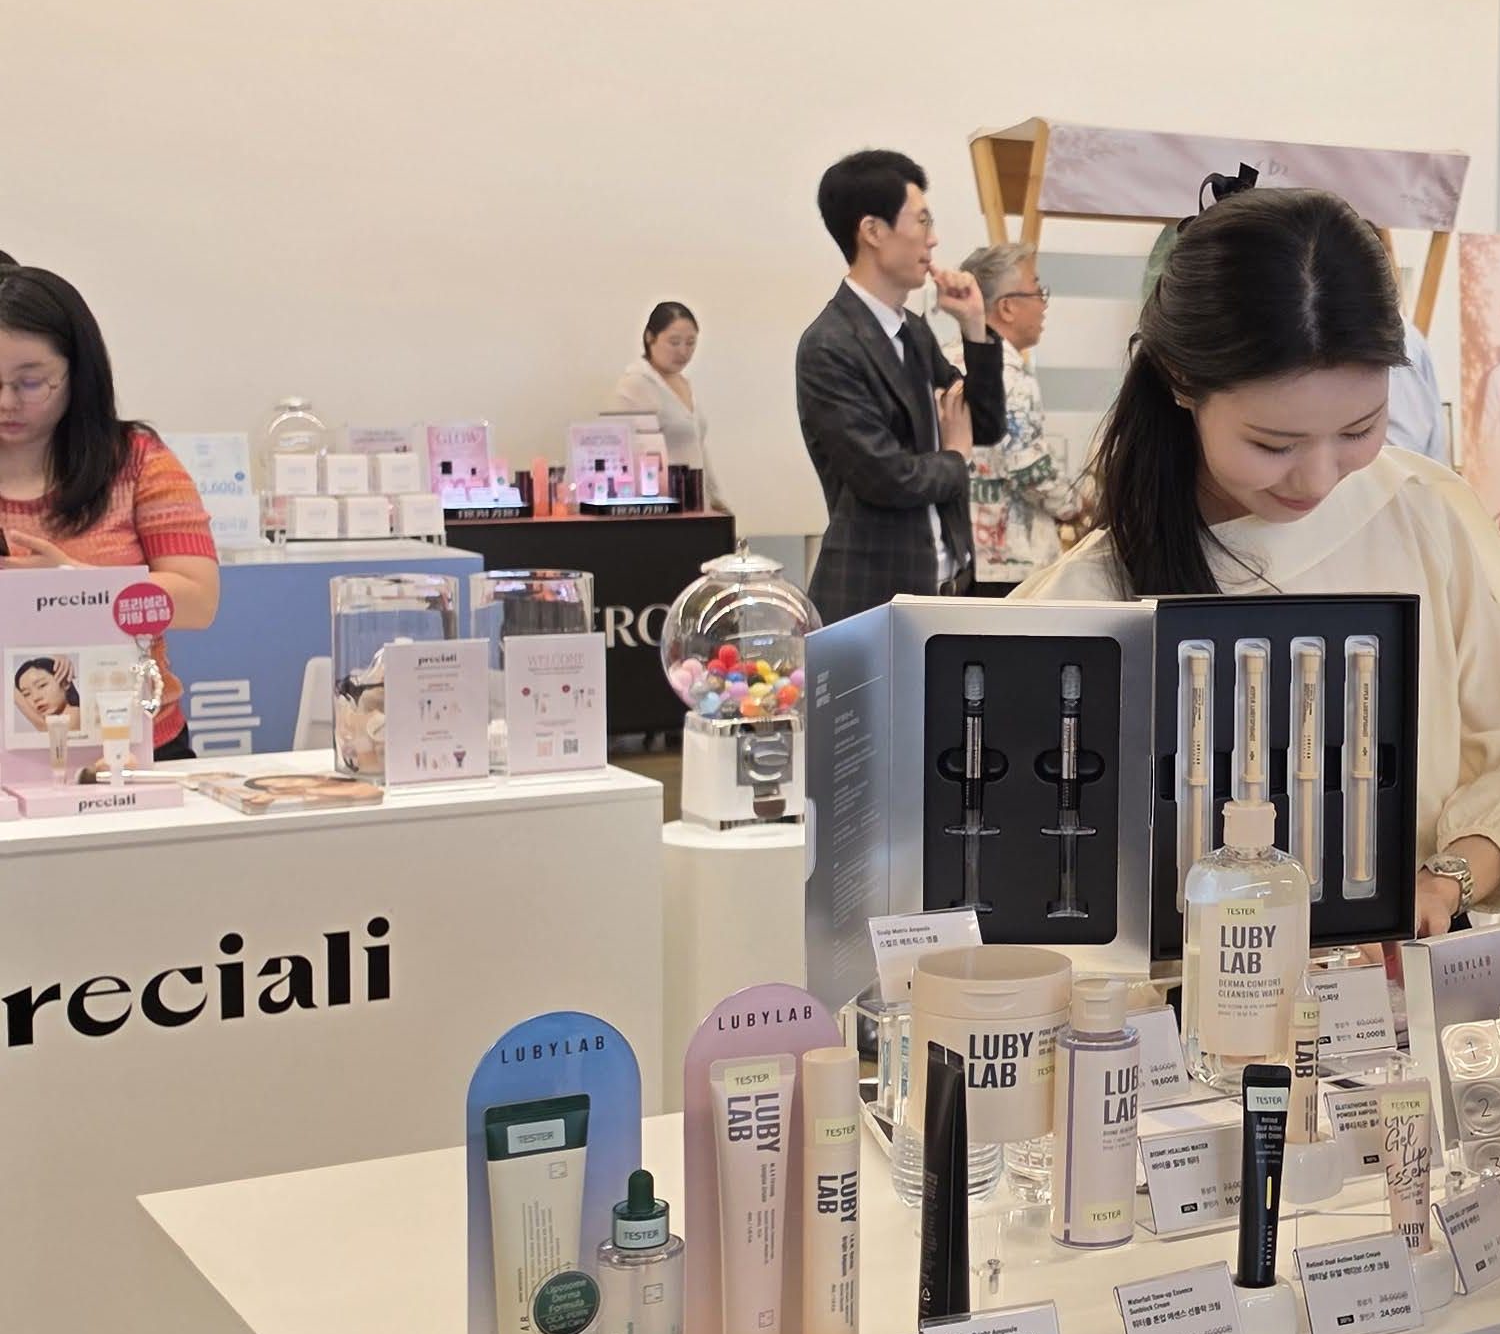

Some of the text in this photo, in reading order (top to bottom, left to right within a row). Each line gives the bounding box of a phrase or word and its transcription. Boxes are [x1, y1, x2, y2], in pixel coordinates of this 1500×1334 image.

[36, 591, 110, 611] preciali
[78, 794, 136, 812] preciali
[1226, 908, 1255, 916] TESTER
[1220, 925, 1276, 949] LUBY
[1220, 951, 1262, 974] LAB
[1218, 977, 1281, 988] DERMA COMFORT
[1218, 987, 1285, 999] CLEANSING WATER
[717, 1005, 813, 1030] LUBYLAB
[1356, 1029, 1386, 1040] 42,000원
[502, 1035, 606, 1064] LUBYLAB
[968, 1032, 1034, 1060] LUBY
[1296, 1040, 1314, 1078] LAB
[735, 1074, 770, 1085] TESTER
[968, 1062, 1017, 1088] LAB
[1105, 1065, 1139, 1096] LUB
[1151, 1075, 1180, 1087] 19,600원
[1256, 1096, 1283, 1106] TESTER
[1391, 1101, 1420, 1109] TESTER
[1478, 1097, 1492, 1117] 2
[1103, 1094, 1138, 1125] LAB
[727, 1096, 753, 1143] LAB
[754, 1093, 781, 1153] LUBY
[517, 1131, 554, 1144] TESTER
[825, 1124, 857, 1138] TESTER
[1385, 1122, 1418, 1152] Gel
[1168, 1145, 1191, 1155] HEALING
[1191, 1142, 1208, 1151] WATER
[817, 1175, 838, 1216] LAB
[840, 1171, 858, 1222] LUBY
[1092, 1210, 1121, 1221] TESTER
[624, 1229, 659, 1241] TESTER
[1325, 1250, 1381, 1266] Dual Active Spot Cream
[1329, 1268, 1342, 1278] 듀얼
[1376, 1260, 1390, 1269] 크림
[545, 1280, 588, 1295] Liposome
[1172, 1287, 1193, 1297] Essence
[551, 1291, 581, 1304] Derma
[548, 1299, 585, 1313] Formula
[1129, 1301, 1170, 1315] Sunblock Cream
[1167, 1309, 1187, 1322] 에센스
[1208, 1300, 1222, 1312] 크림
[1379, 1304, 1411, 1318] 24,500원
